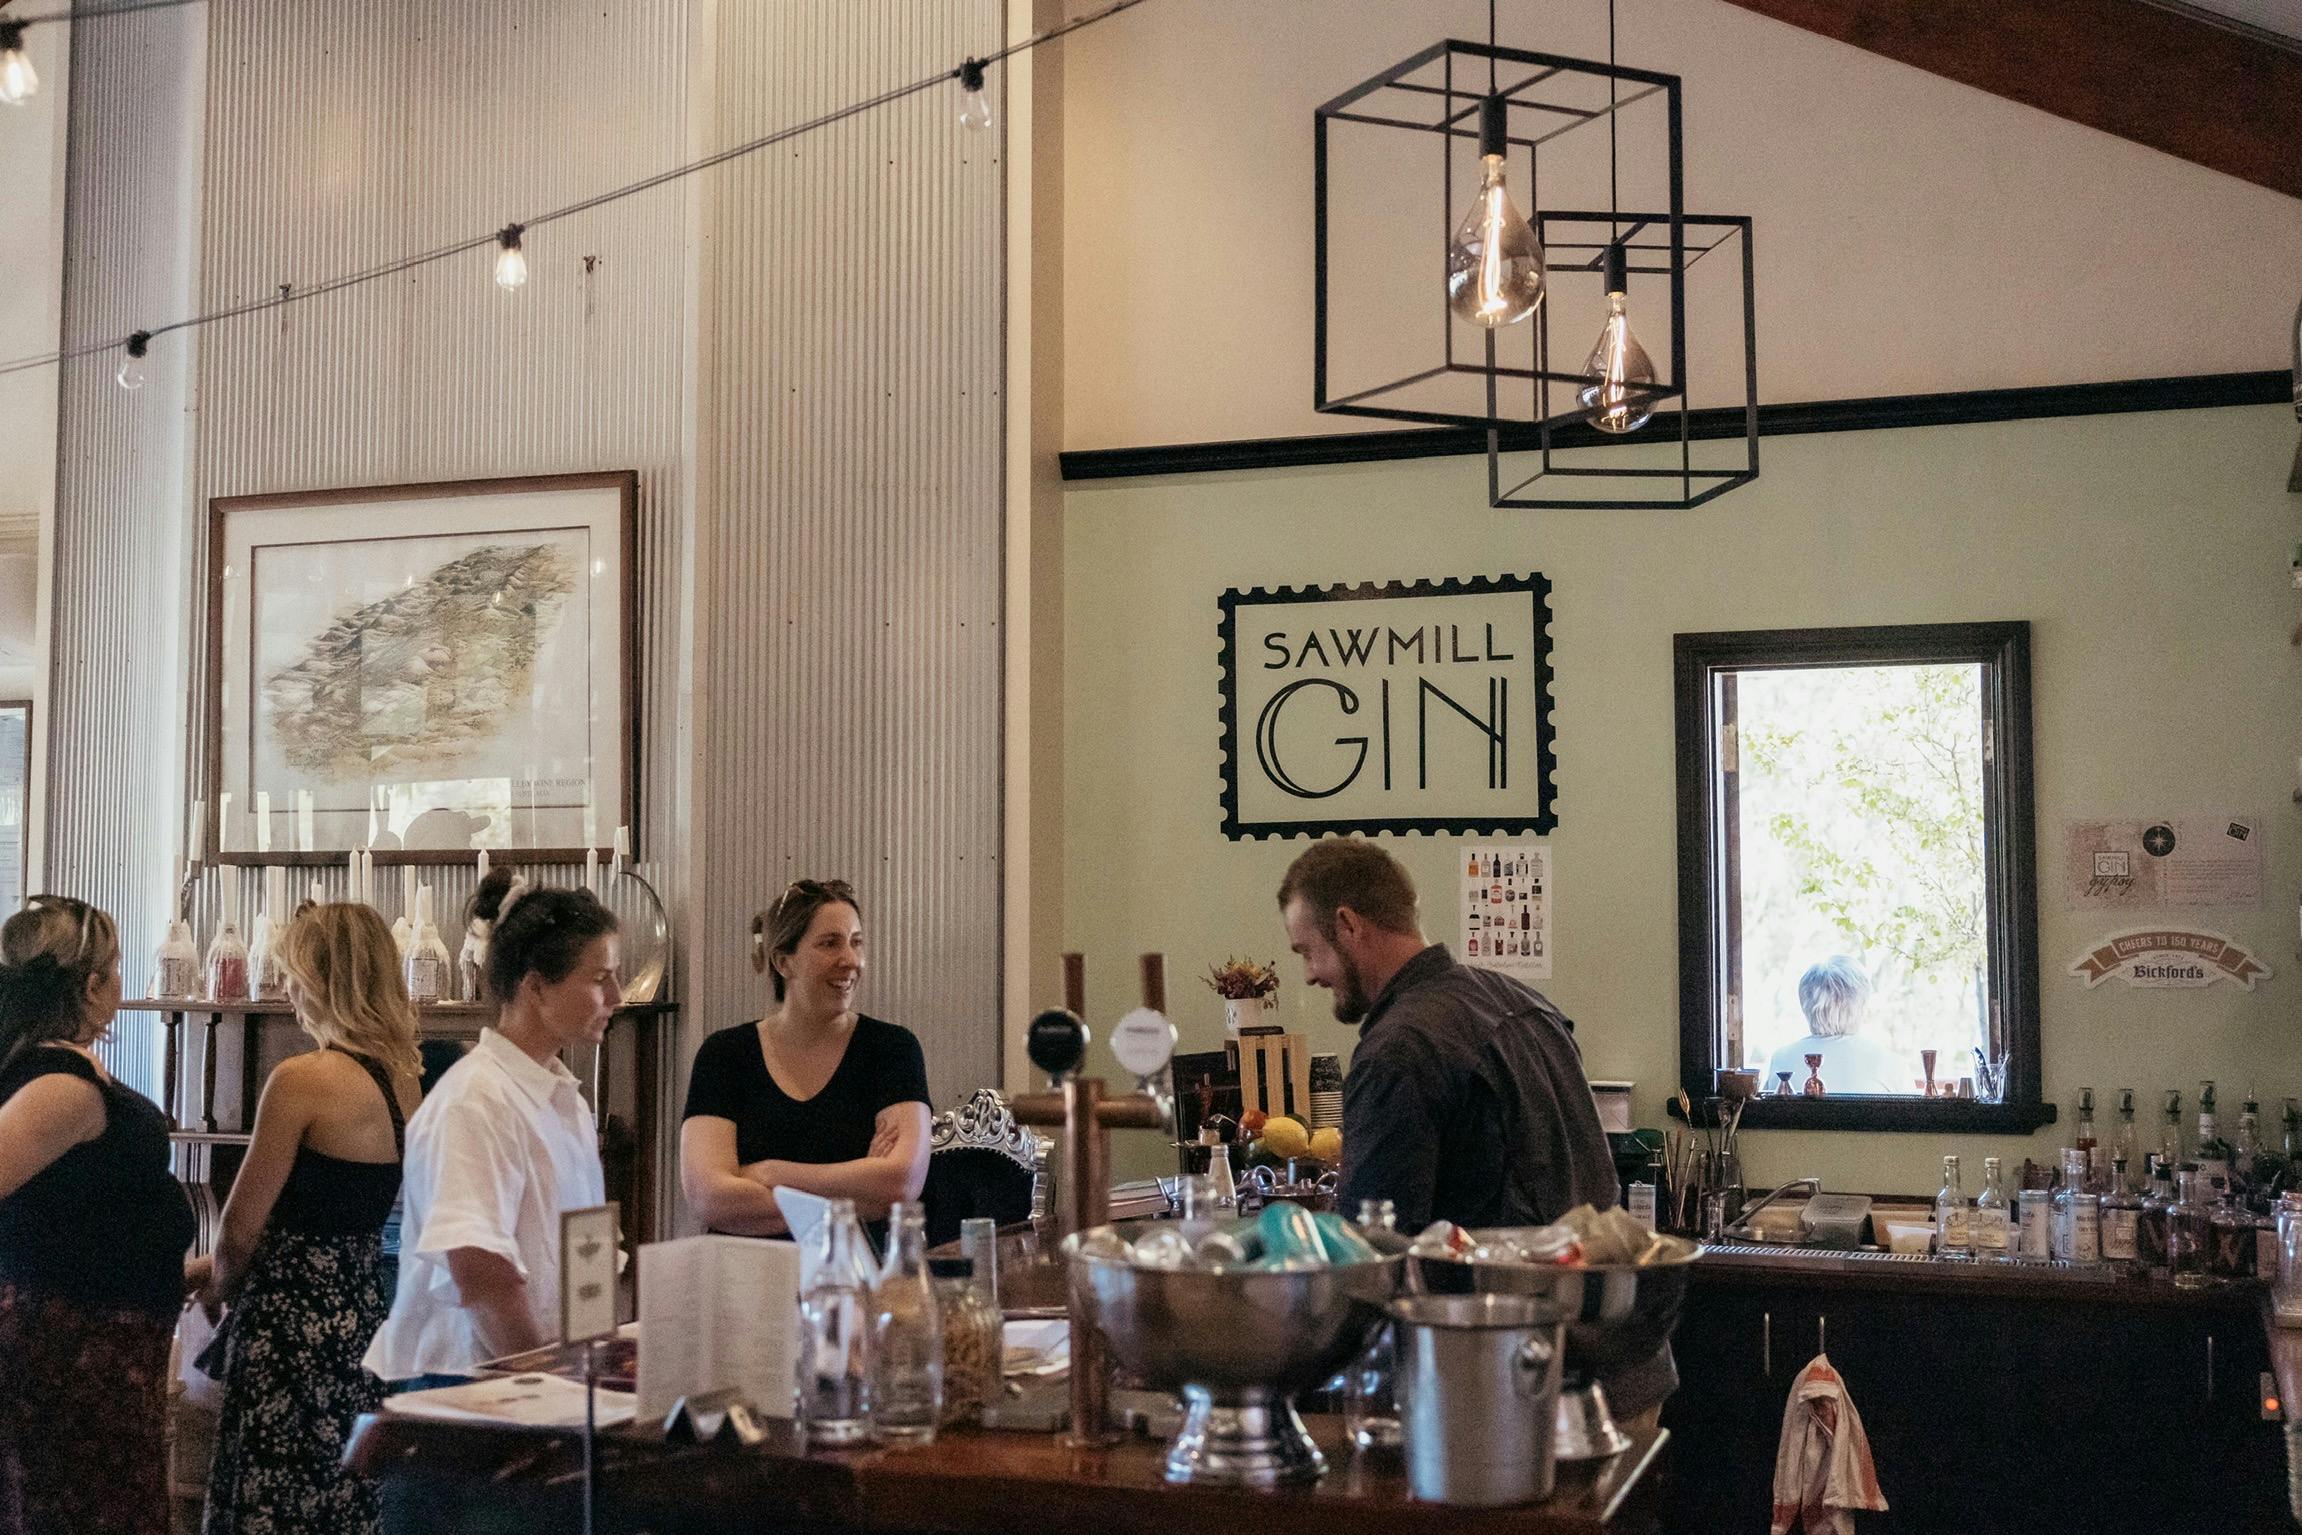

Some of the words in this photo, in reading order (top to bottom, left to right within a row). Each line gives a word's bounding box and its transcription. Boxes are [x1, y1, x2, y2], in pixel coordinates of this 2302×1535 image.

[1263, 622, 1514, 669] SAWMILL
[1256, 676, 1508, 799] GIN
[2097, 860, 2126, 873] GIN
[2119, 936, 2153, 952] CHEERS
[2155, 935, 2168, 946] TO
[2170, 935, 2187, 947] 150
[2190, 938, 2220, 953] YEARS
[2132, 965, 2204, 979] Bickford's
